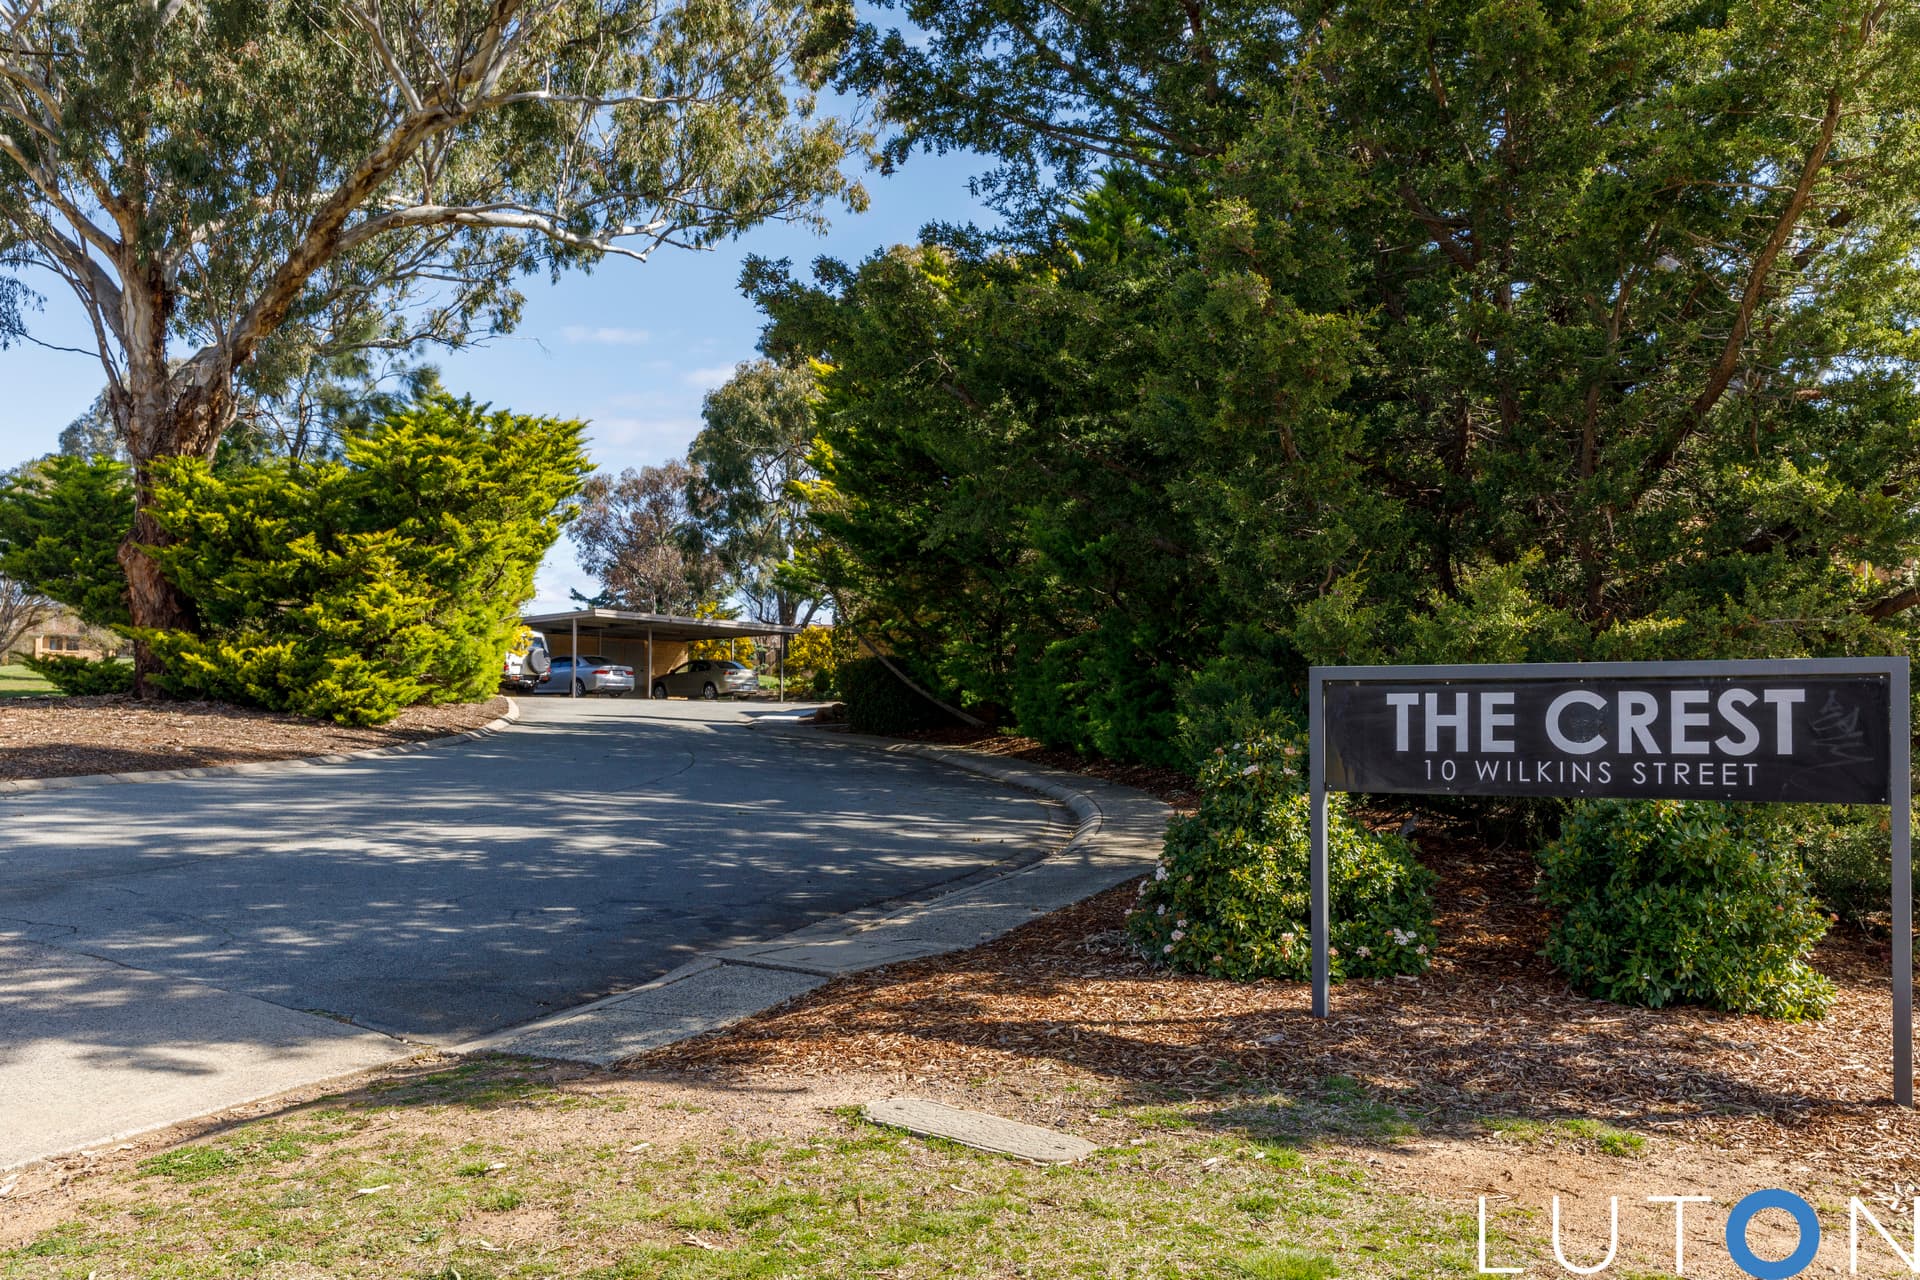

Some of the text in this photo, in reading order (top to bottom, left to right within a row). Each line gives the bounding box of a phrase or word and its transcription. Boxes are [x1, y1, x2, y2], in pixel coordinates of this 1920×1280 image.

[1386, 692, 1515, 753] THE
[1545, 688, 1806, 757] CREST
[1424, 759, 1758, 786] 10 WILKINS STREET
